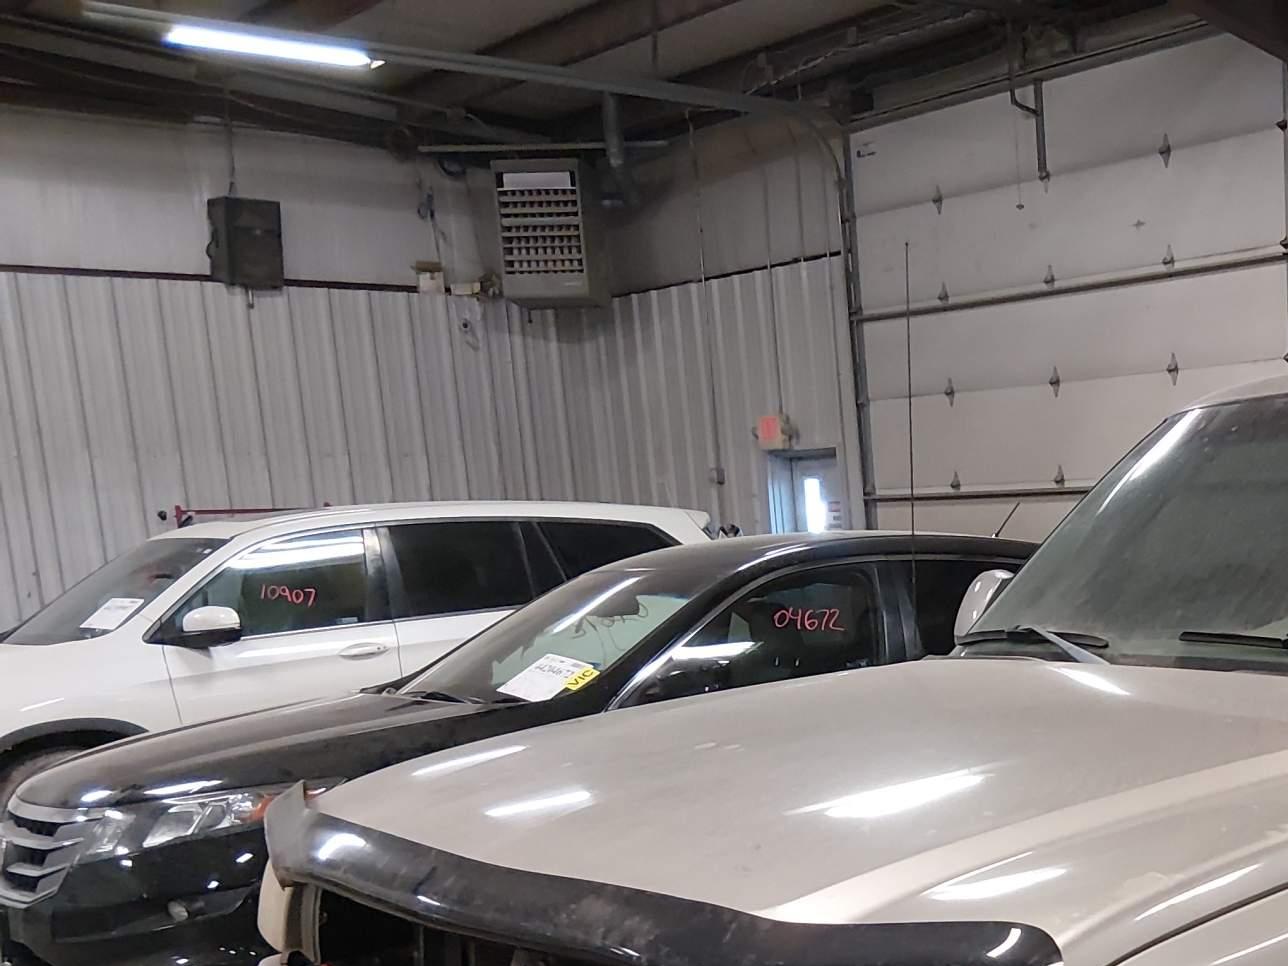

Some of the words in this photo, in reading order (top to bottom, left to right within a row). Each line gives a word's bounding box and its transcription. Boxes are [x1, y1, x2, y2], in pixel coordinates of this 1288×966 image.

[260, 583, 316, 608] 10907
[773, 608, 846, 632] 04672
[567, 669, 594, 687] VIC
